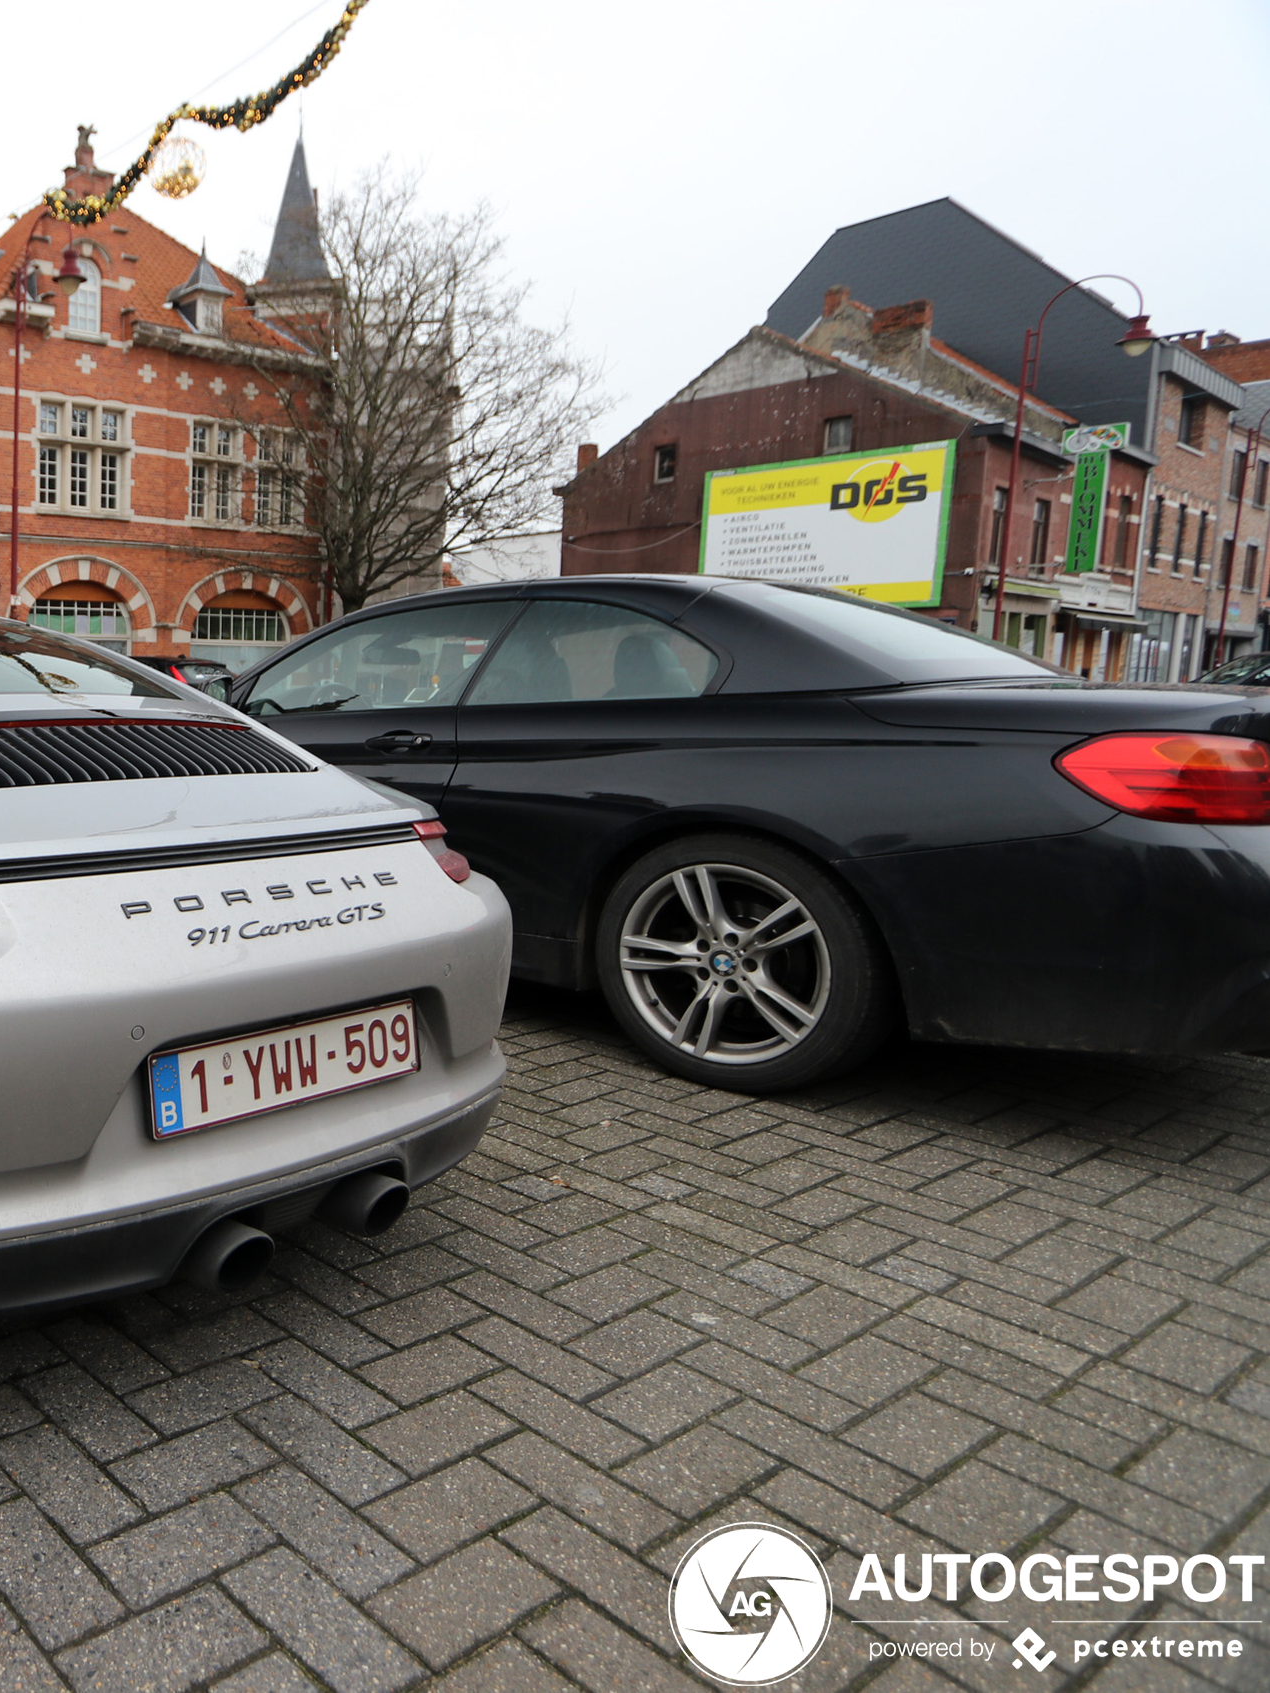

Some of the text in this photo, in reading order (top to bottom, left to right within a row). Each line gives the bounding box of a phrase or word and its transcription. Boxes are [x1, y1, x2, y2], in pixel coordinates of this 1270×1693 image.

[722, 476, 820, 495] VOOR AL UW ENERGIE
[830, 473, 927, 510] DGS
[737, 491, 797, 505] TECHNIEKEN
[730, 514, 760, 523] AIRCO
[729, 522, 785, 534] VENTILATIE
[729, 531, 808, 545] ZONNEPANELEN
[728, 543, 812, 556] WARMTEPOMPEN
[728, 554, 817, 567] THUISBATTERIJEN
[121, 871, 399, 919] PORSCHE
[187, 902, 386, 947] 911 Carrera GTS
[191, 1013, 411, 1114] 1-YWW-509
[160, 1100, 178, 1128] B
